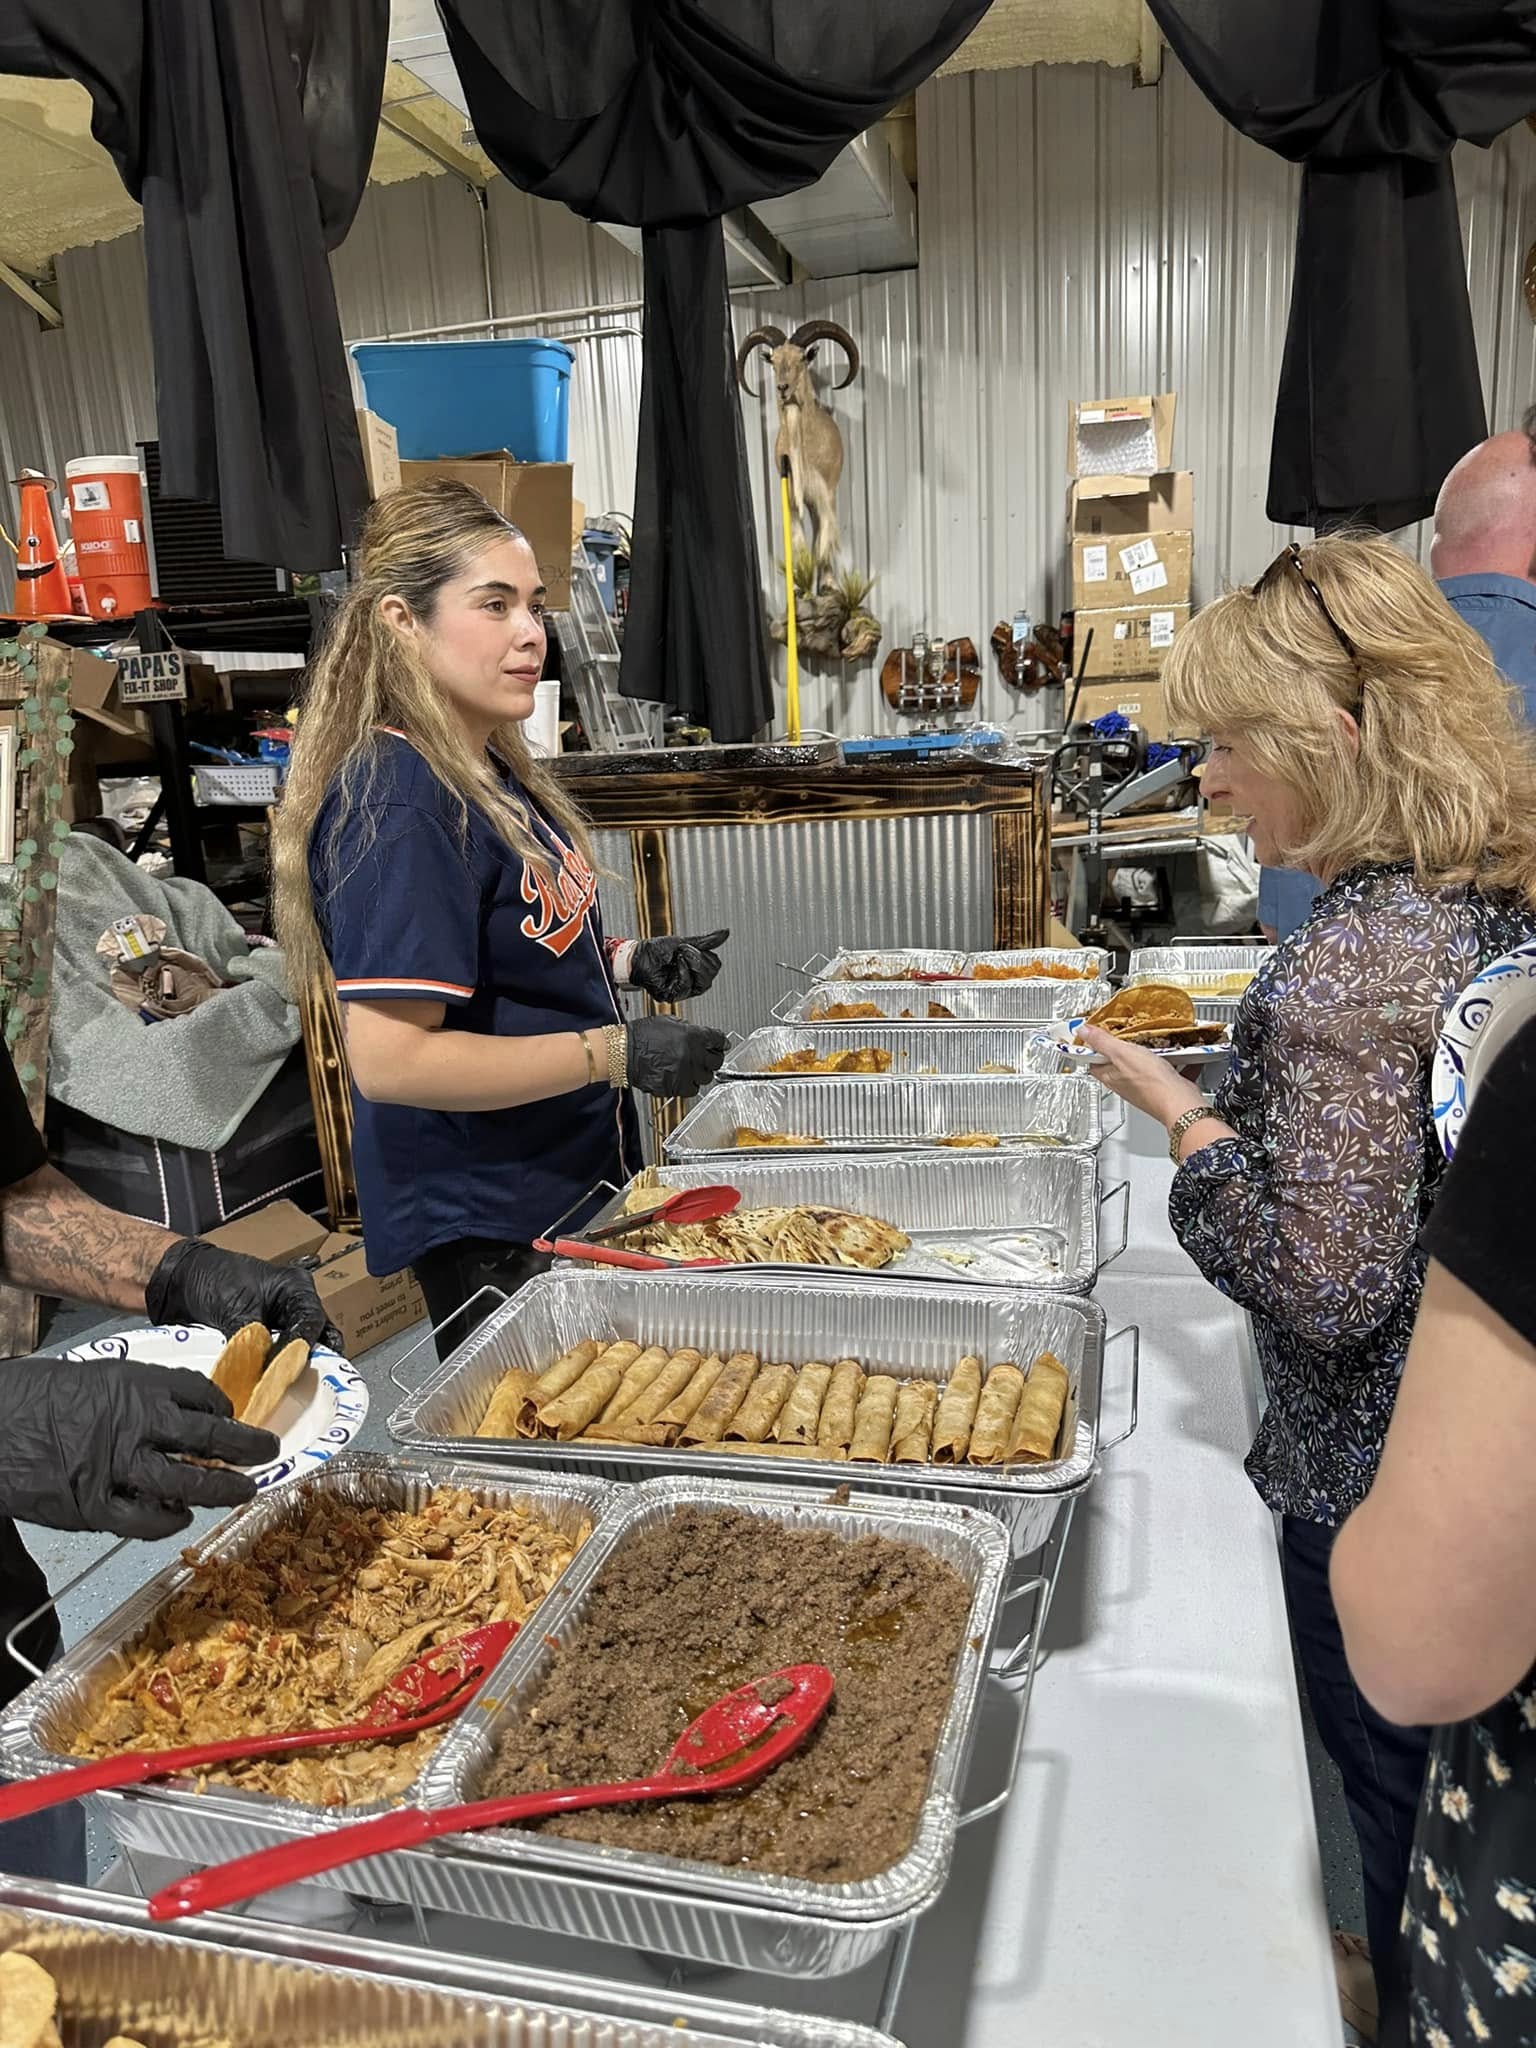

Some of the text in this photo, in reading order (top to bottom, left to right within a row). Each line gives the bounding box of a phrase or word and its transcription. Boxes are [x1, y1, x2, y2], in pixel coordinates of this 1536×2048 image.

[118, 653, 181, 680] PAPA'S
[124, 679, 178, 694] FIX-IT SHOP
[380, 1275, 403, 1292] prime
[359, 1293, 406, 1322] to meet you
[355, 1322, 373, 1338] wait
